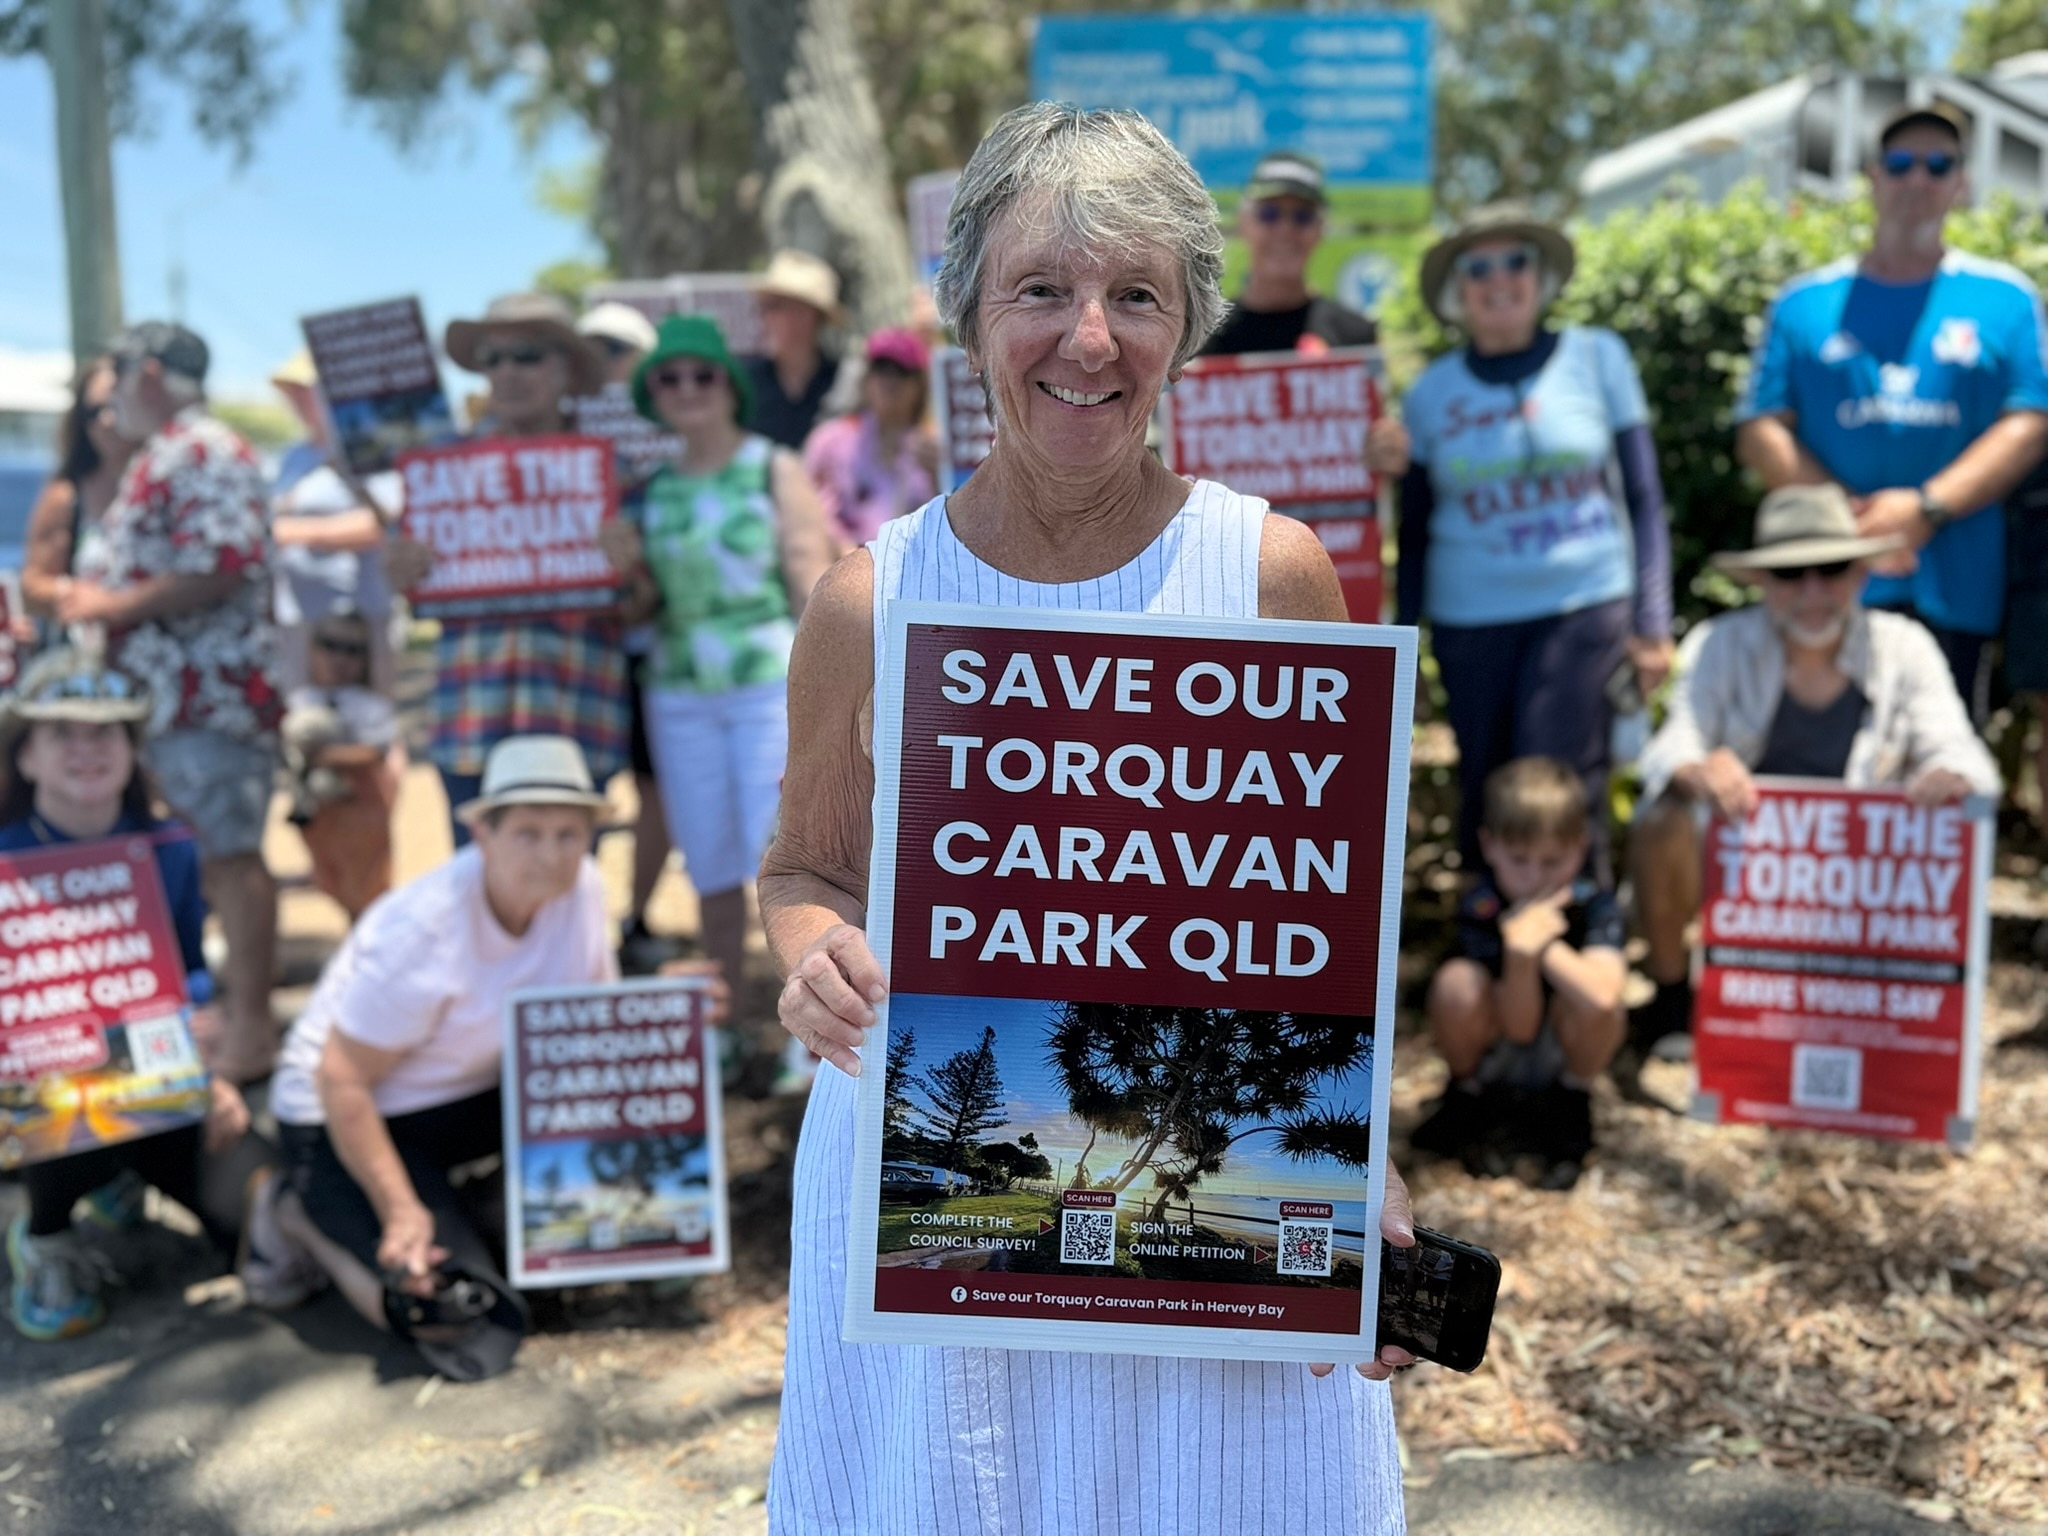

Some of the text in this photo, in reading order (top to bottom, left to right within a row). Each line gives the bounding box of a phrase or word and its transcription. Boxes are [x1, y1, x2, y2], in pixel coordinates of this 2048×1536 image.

[1176, 363, 1369, 421] SAVE THE
[404, 445, 602, 505] SAVE THE
[406, 500, 603, 555] TORQUAY
[941, 649, 1350, 723] SAVE OUR
[936, 734, 1345, 809] TORQUAY
[1859, 803, 1964, 858] THE
[931, 820, 1351, 895] CARAVAN
[1716, 851, 1963, 913] TORQUAY
[0, 861, 133, 914] AVE OUR
[0, 895, 139, 949] ORQUAY
[929, 905, 1331, 983] PARK QLD
[1711, 902, 1960, 951] CARAVAN PARK
[0, 979, 91, 1027] PARK
[90, 966, 160, 1010] QLD
[524, 992, 692, 1033] SAVE OUR
[525, 1026, 692, 1065] TORQUAY
[525, 1058, 699, 1100] CARAVAN
[525, 1091, 696, 1135] PARK QLD
[910, 1212, 1014, 1229] COMPLETE THE
[1066, 1193, 1113, 1204] SCAN HERE
[1283, 1205, 1330, 1215] SCAN HERE
[909, 1234, 1036, 1251] COUNCIL SURVEY!
[1129, 1243, 1245, 1260] ONLINE PETITION
[1130, 1221, 1194, 1236] SIGN THE
[972, 1289, 1007, 1302] Save
[1008, 1292, 1033, 1303] our
[1035, 1292, 1092, 1308] Torquay
[1094, 1295, 1155, 1309] Caravan
[1157, 1298, 1188, 1311] Park
[1191, 1299, 1204, 1312] in
[1207, 1300, 1256, 1317] Hervey
[1258, 1303, 1285, 1319] Bay
